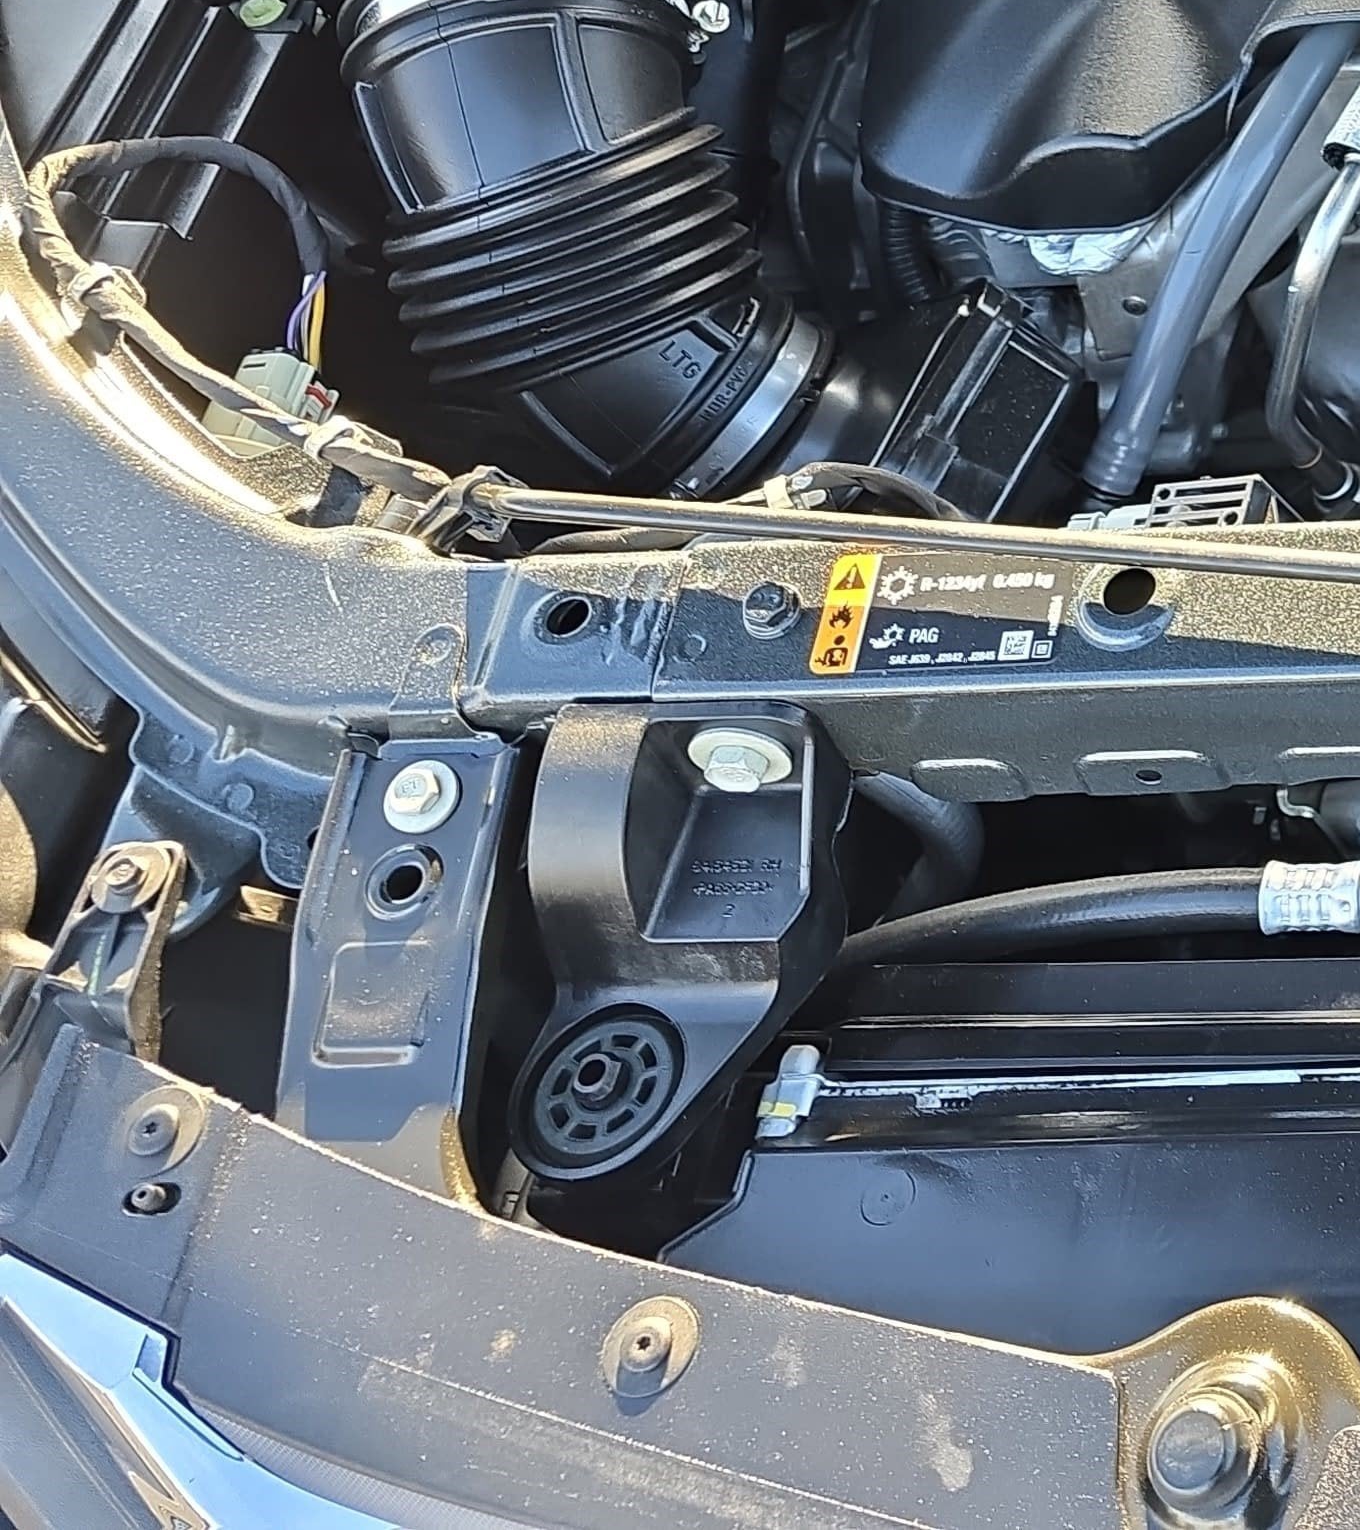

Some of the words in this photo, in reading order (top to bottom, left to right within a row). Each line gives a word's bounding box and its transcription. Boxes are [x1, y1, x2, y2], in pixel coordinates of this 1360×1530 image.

[659, 340, 702, 379] LTG
[1034, 571, 1056, 590] kg
[908, 626, 940, 644] PAG
[887, 654, 908, 665] SAE
